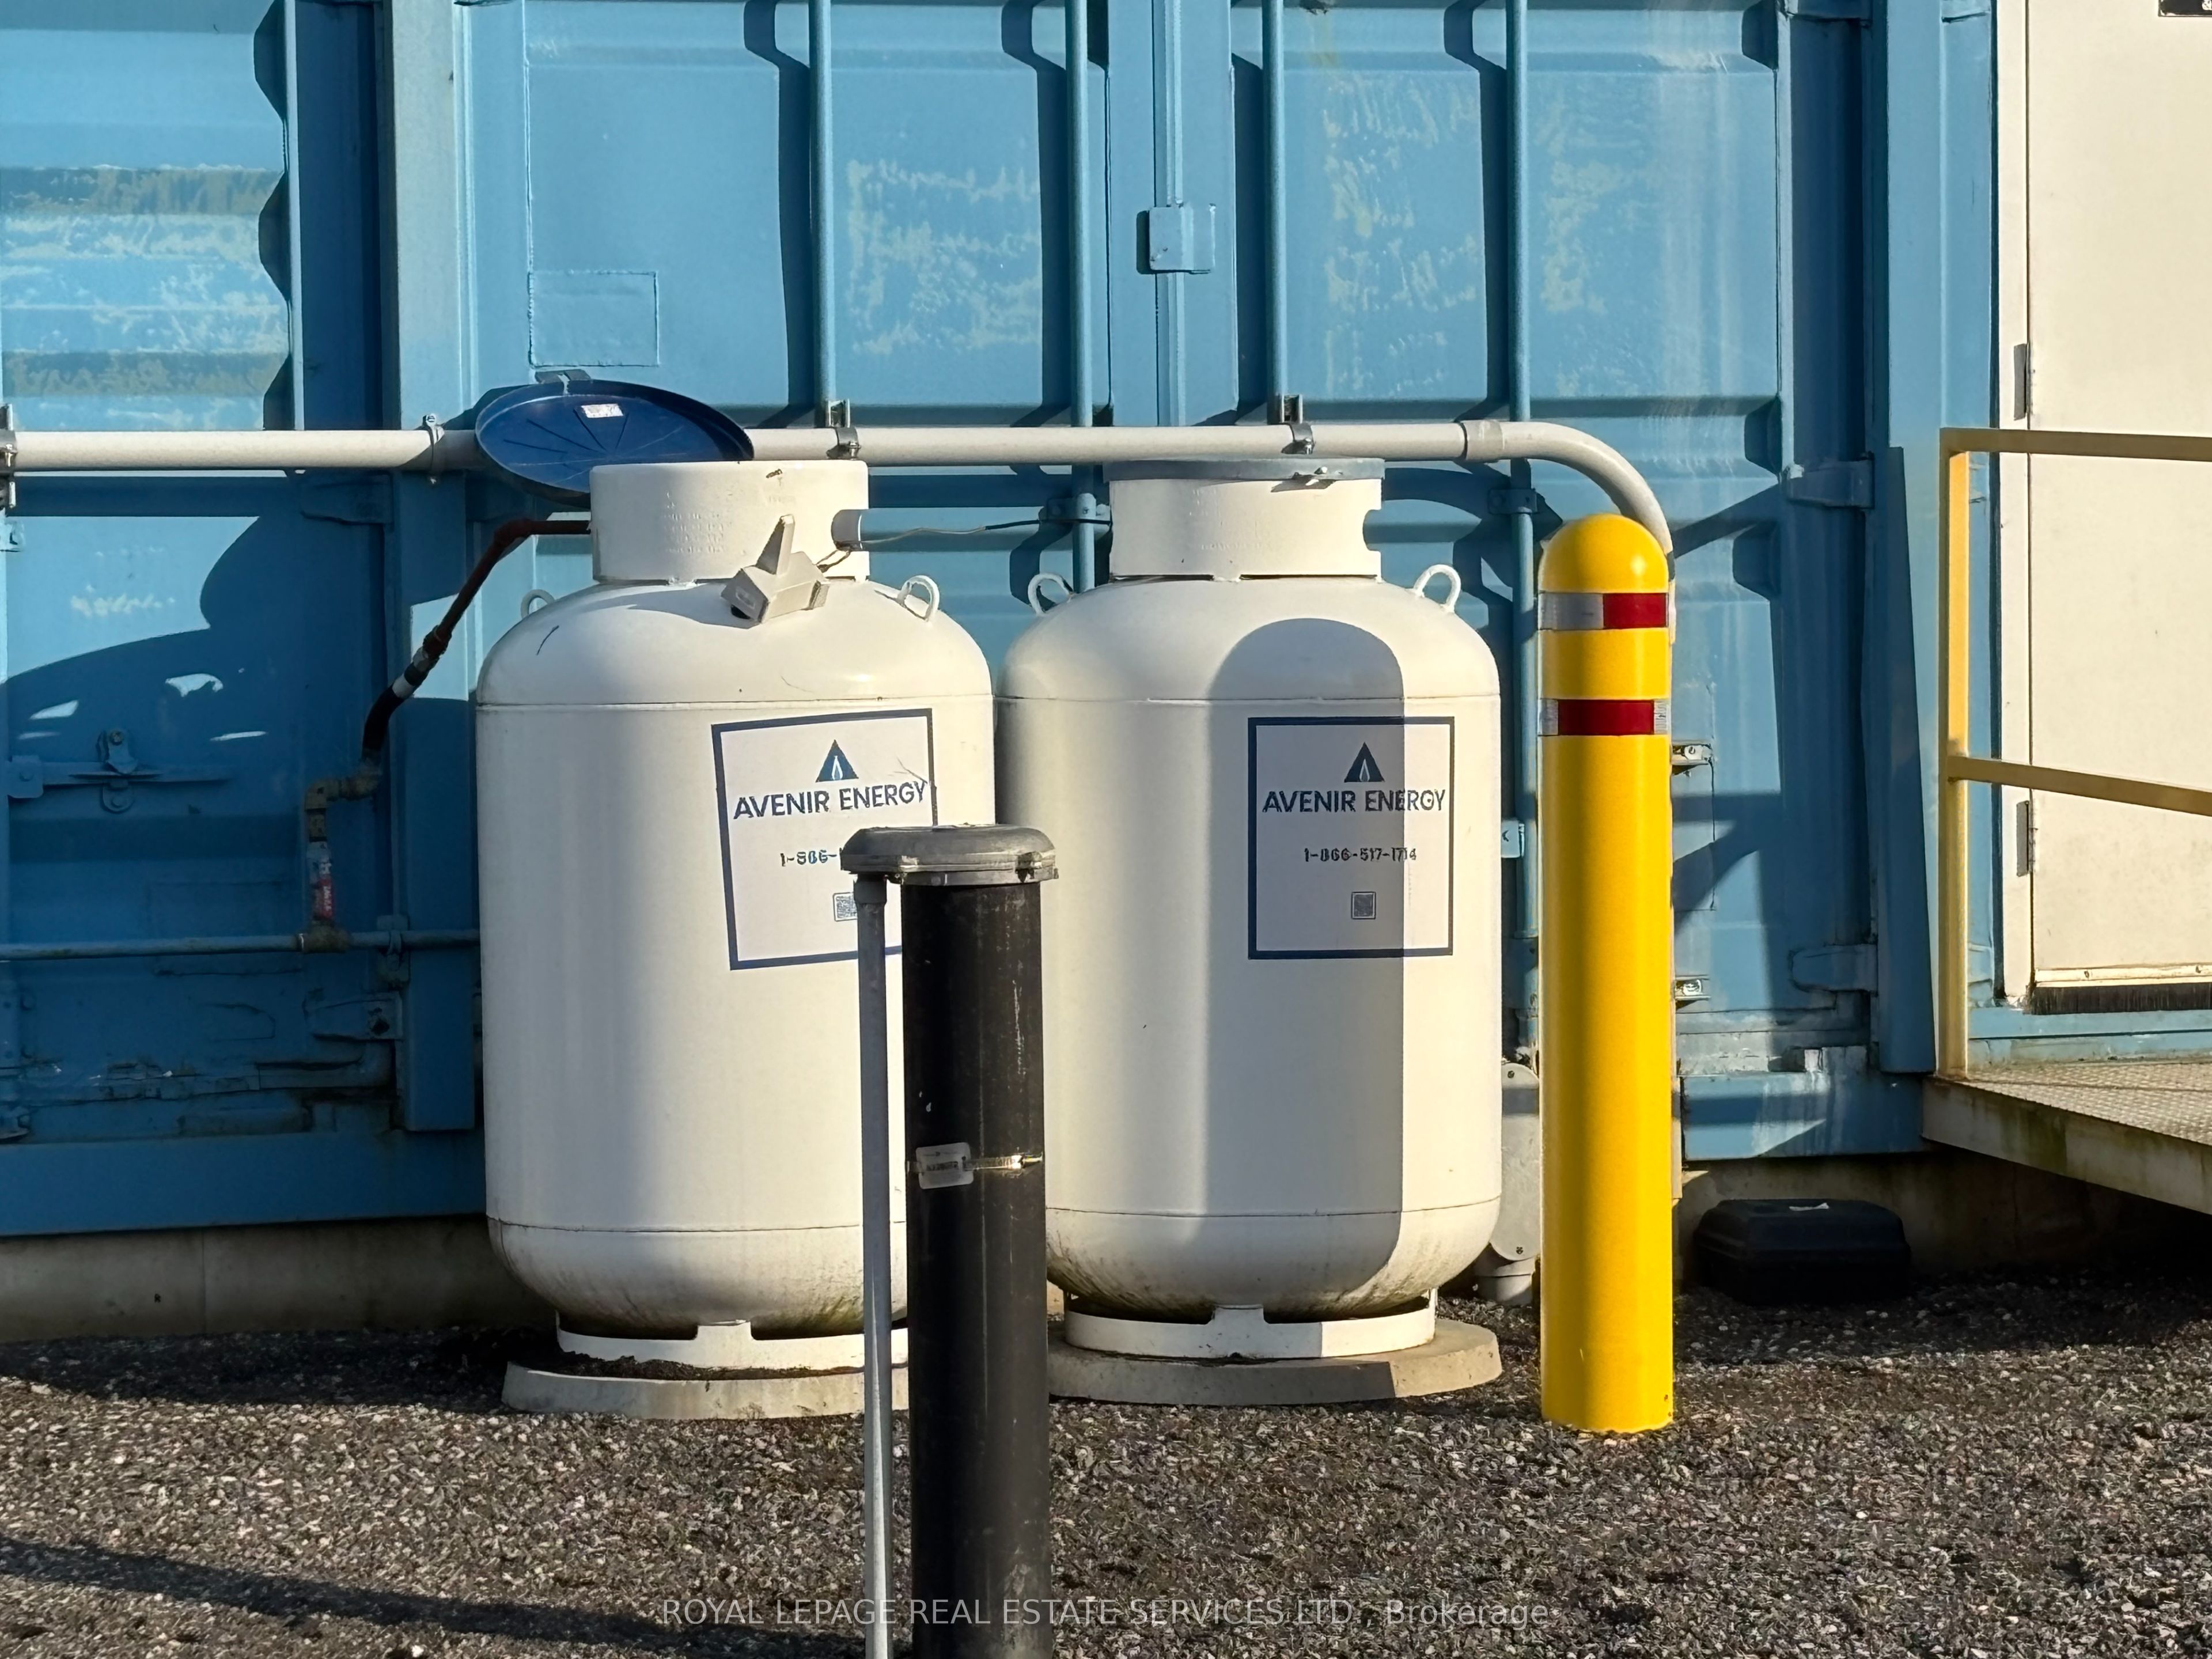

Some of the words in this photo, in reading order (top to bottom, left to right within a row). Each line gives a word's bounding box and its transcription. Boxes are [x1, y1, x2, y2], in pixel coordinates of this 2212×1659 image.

[733, 791, 830, 819] AVENIR
[839, 781, 927, 810] ENERGY
[1262, 790, 1356, 812] AVENIR
[1365, 789, 1446, 811] ENERGY
